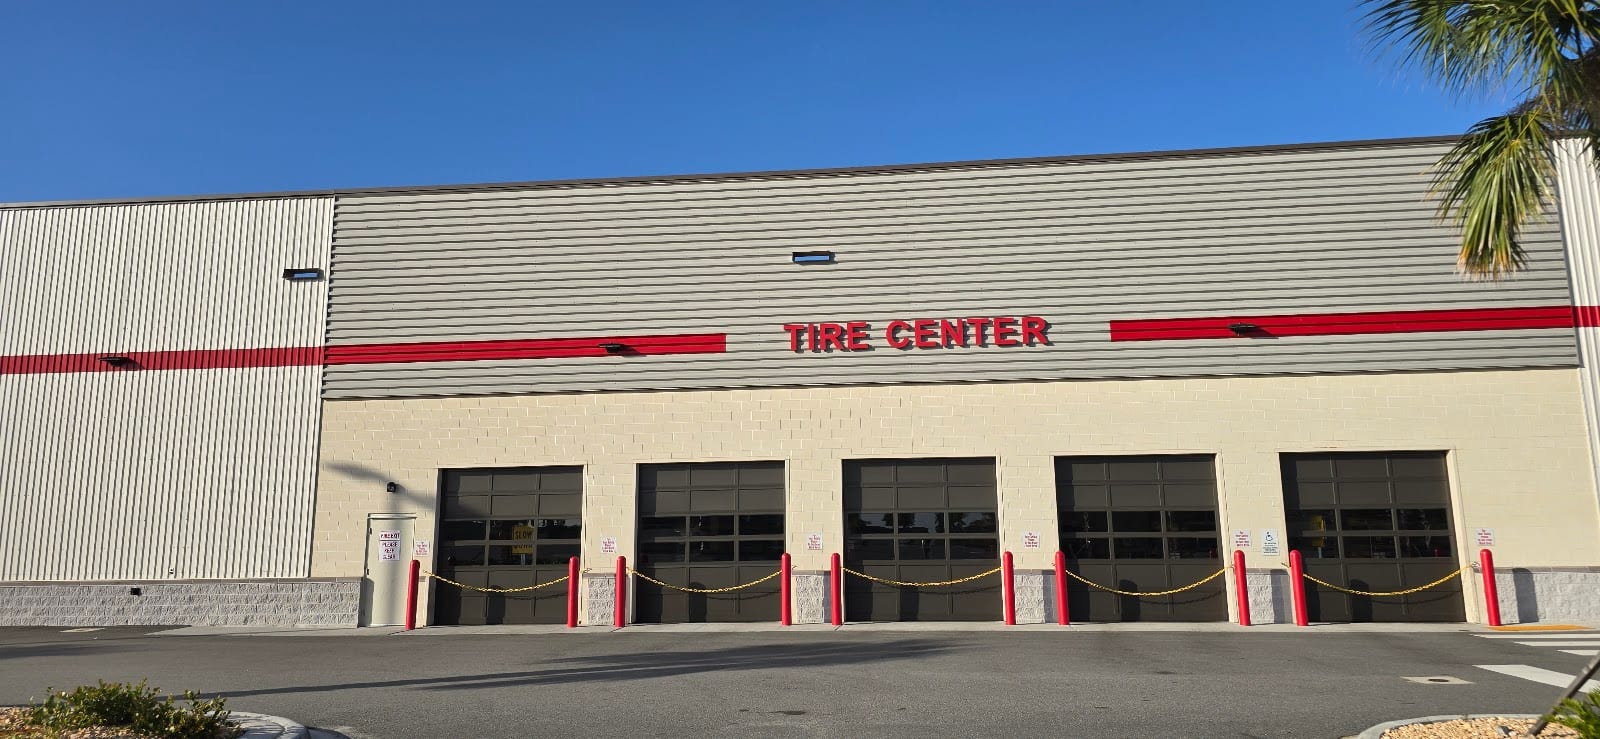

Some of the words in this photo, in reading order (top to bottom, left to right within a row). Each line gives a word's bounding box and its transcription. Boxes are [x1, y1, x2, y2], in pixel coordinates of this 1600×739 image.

[784, 321, 869, 351] TIRE
[886, 316, 1049, 349] CENTER
[515, 530, 533, 539] SLOW
